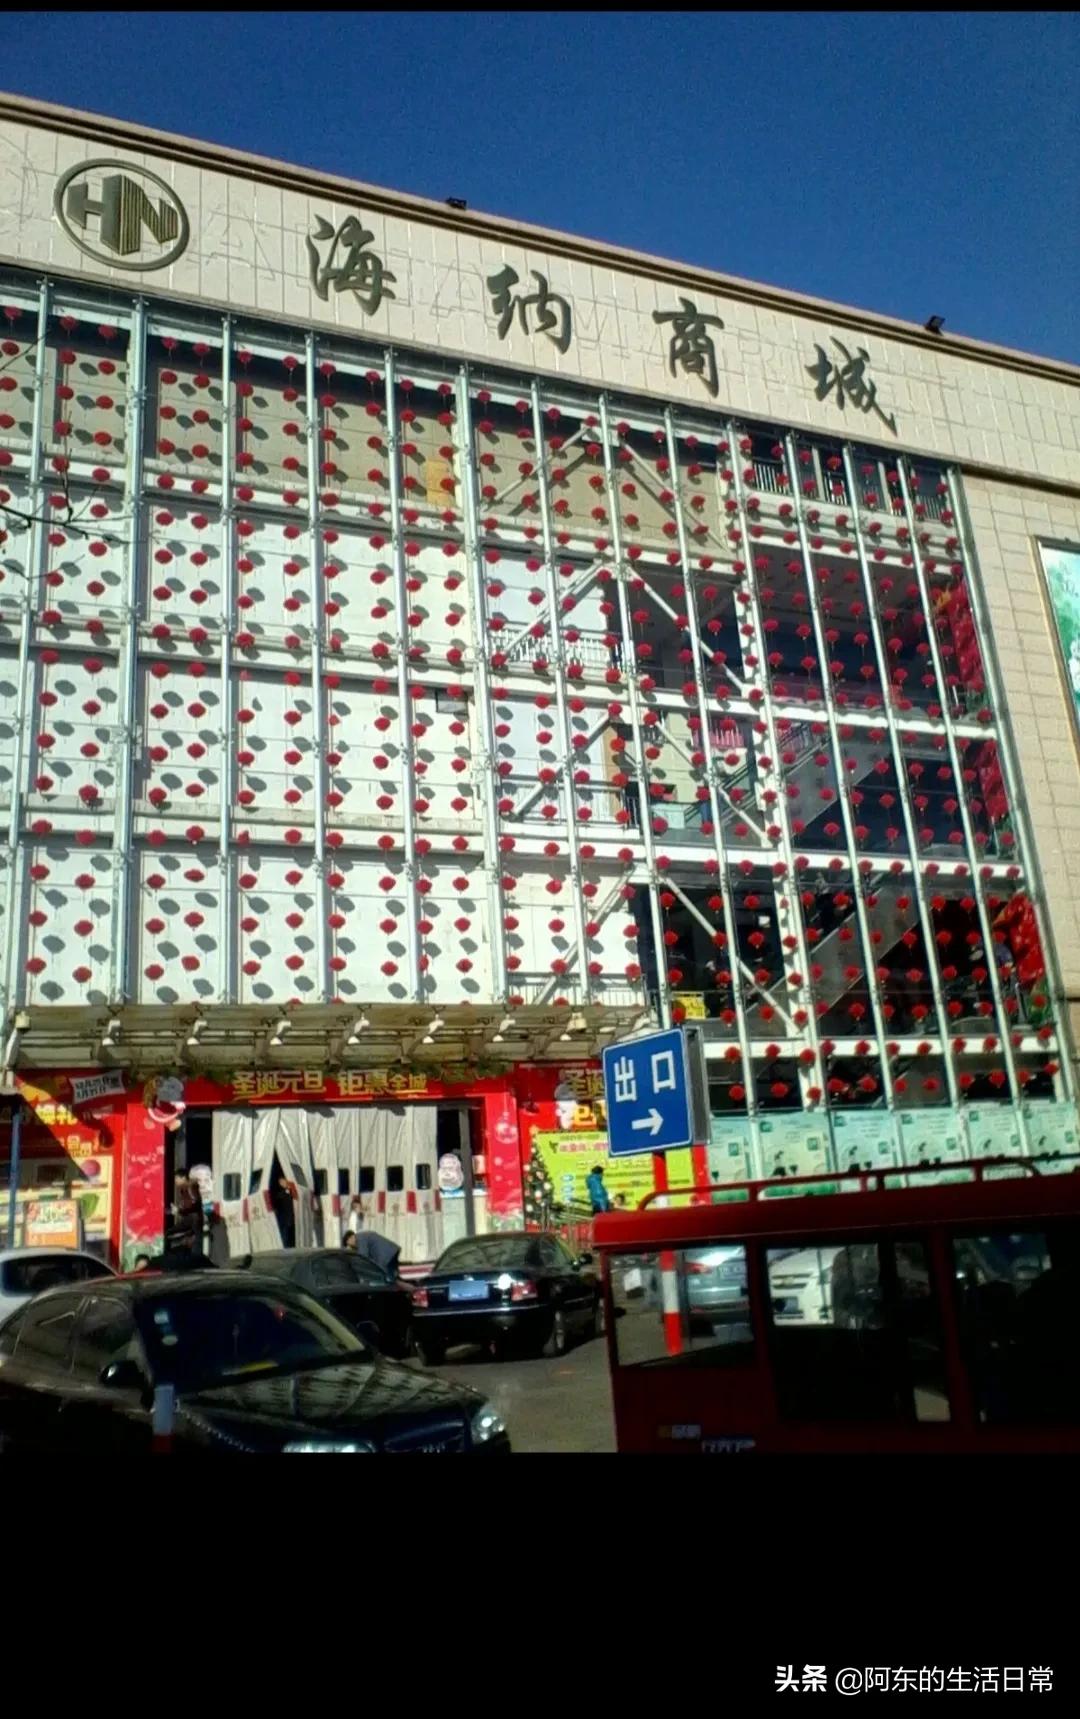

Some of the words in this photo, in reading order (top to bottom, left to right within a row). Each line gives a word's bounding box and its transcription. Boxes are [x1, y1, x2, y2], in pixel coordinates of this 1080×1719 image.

[305, 212, 898, 437] 海纳商城
[232, 1070, 327, 1098] 圣诞元旦
[614, 1049, 677, 1103] 出口
